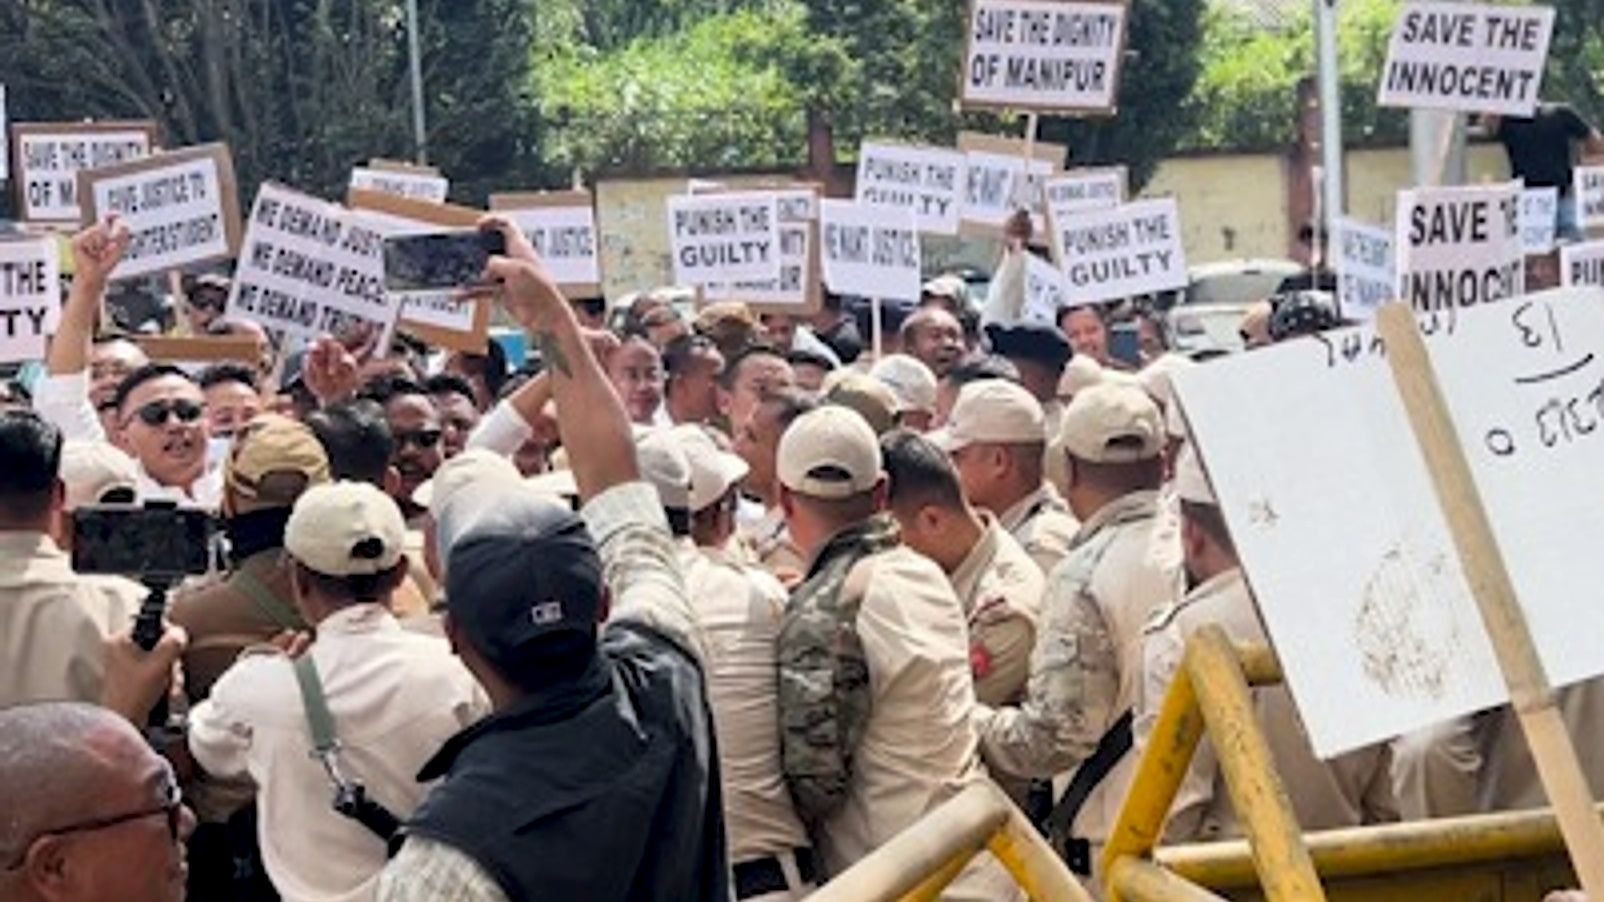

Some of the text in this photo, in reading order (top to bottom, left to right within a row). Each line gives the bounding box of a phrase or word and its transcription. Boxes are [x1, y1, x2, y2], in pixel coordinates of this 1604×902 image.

[975, 9, 1117, 47] SAVE THE DIGNITY
[1403, 11, 1541, 50] SAVE THE
[971, 54, 1105, 91] OF MANIPUR
[1388, 62, 1534, 100] INNOCENT
[24, 141, 58, 169] SAVE
[61, 141, 86, 169] THE
[864, 157, 956, 190] PUNISH THE
[28, 181, 51, 207] OF
[257, 197, 383, 257] WE DEMAND JUST
[675, 206, 769, 237] PUNISH THE
[1063, 214, 1171, 255] PUNISH THE
[1408, 202, 1489, 247] SAVE
[252, 241, 274, 271] WE
[272, 248, 334, 288] DEMAND
[680, 242, 770, 268] GUILTY
[1070, 250, 1174, 288] GUILTY
[3, 260, 46, 296] THE
[235, 281, 259, 312] WE
[259, 288, 318, 328] DEMAND
